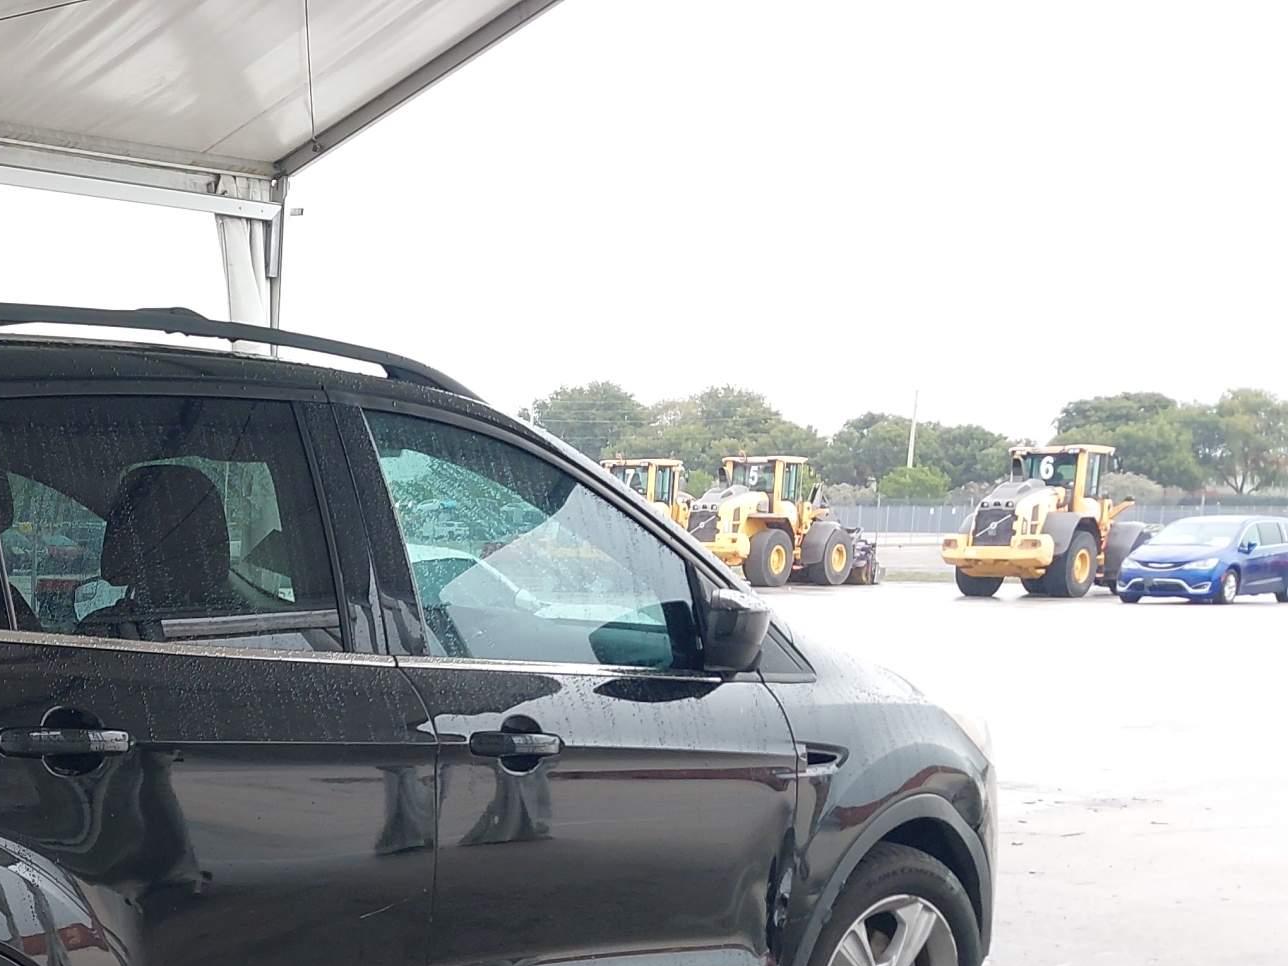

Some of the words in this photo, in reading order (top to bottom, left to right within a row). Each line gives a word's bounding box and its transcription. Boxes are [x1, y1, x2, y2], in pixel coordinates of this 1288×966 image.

[748, 465, 759, 486] 5
[1039, 455, 1054, 480] 6
[624, 468, 636, 489] 7
